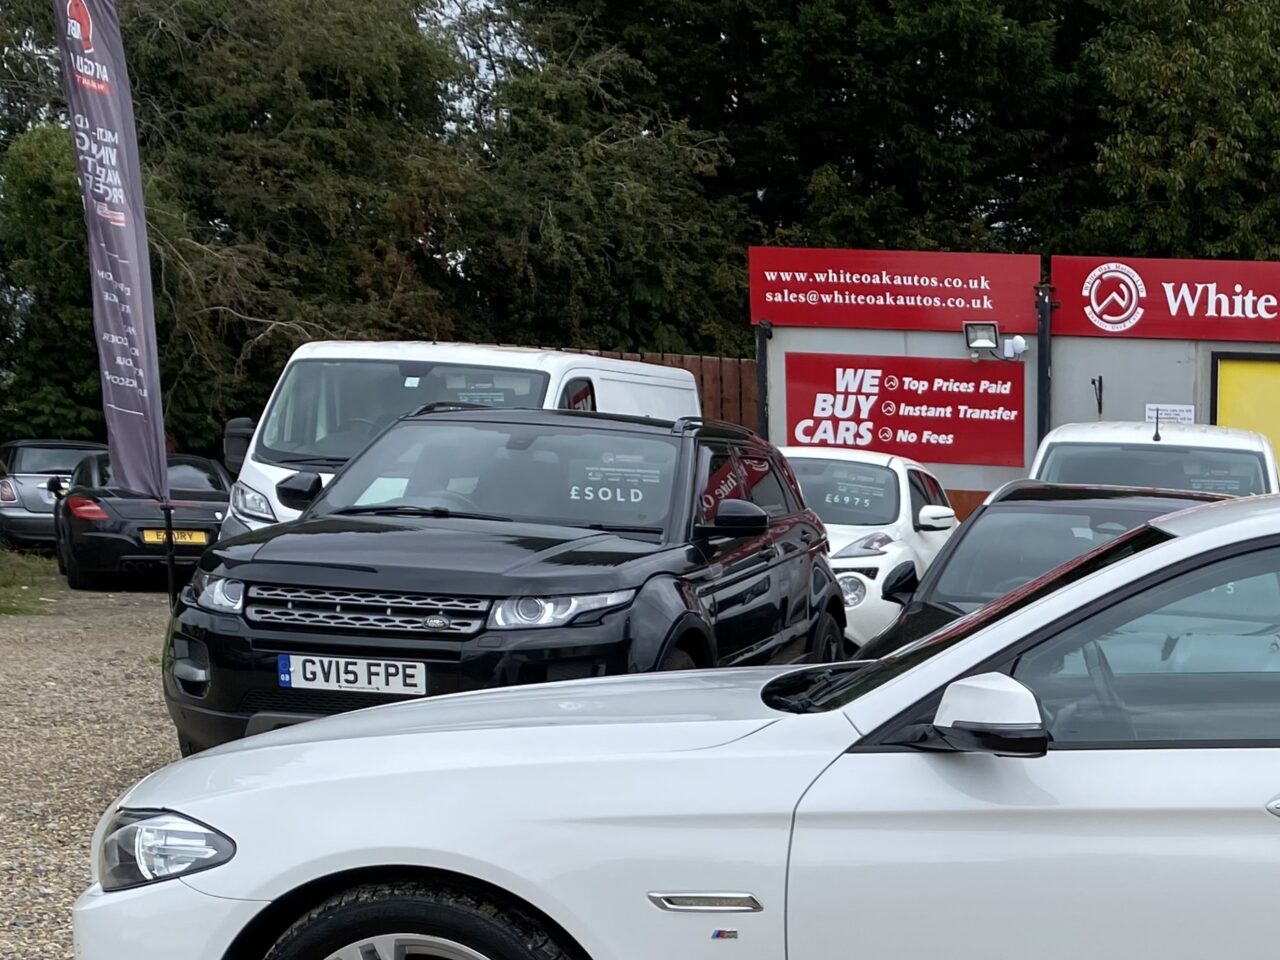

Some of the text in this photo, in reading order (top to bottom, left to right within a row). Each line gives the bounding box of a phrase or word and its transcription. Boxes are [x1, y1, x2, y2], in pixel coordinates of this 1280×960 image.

[764, 269, 991, 290] www.whiteoakautos.co.uk
[1084, 264, 1144, 293] White Oak Motors LTD
[765, 289, 994, 309] sales@whiteoakautos.co.uk
[1161, 281, 1279, 320] White
[835, 368, 882, 393] WE
[902, 377, 1012, 394] Top Prices Paid
[813, 394, 878, 419] BUY
[898, 402, 1018, 421] Instant Transfer
[794, 420, 874, 446] CARS
[896, 429, 954, 445] No Fees
[825, 493, 870, 508] £6975
[302, 658, 418, 688] GV15 FPE
